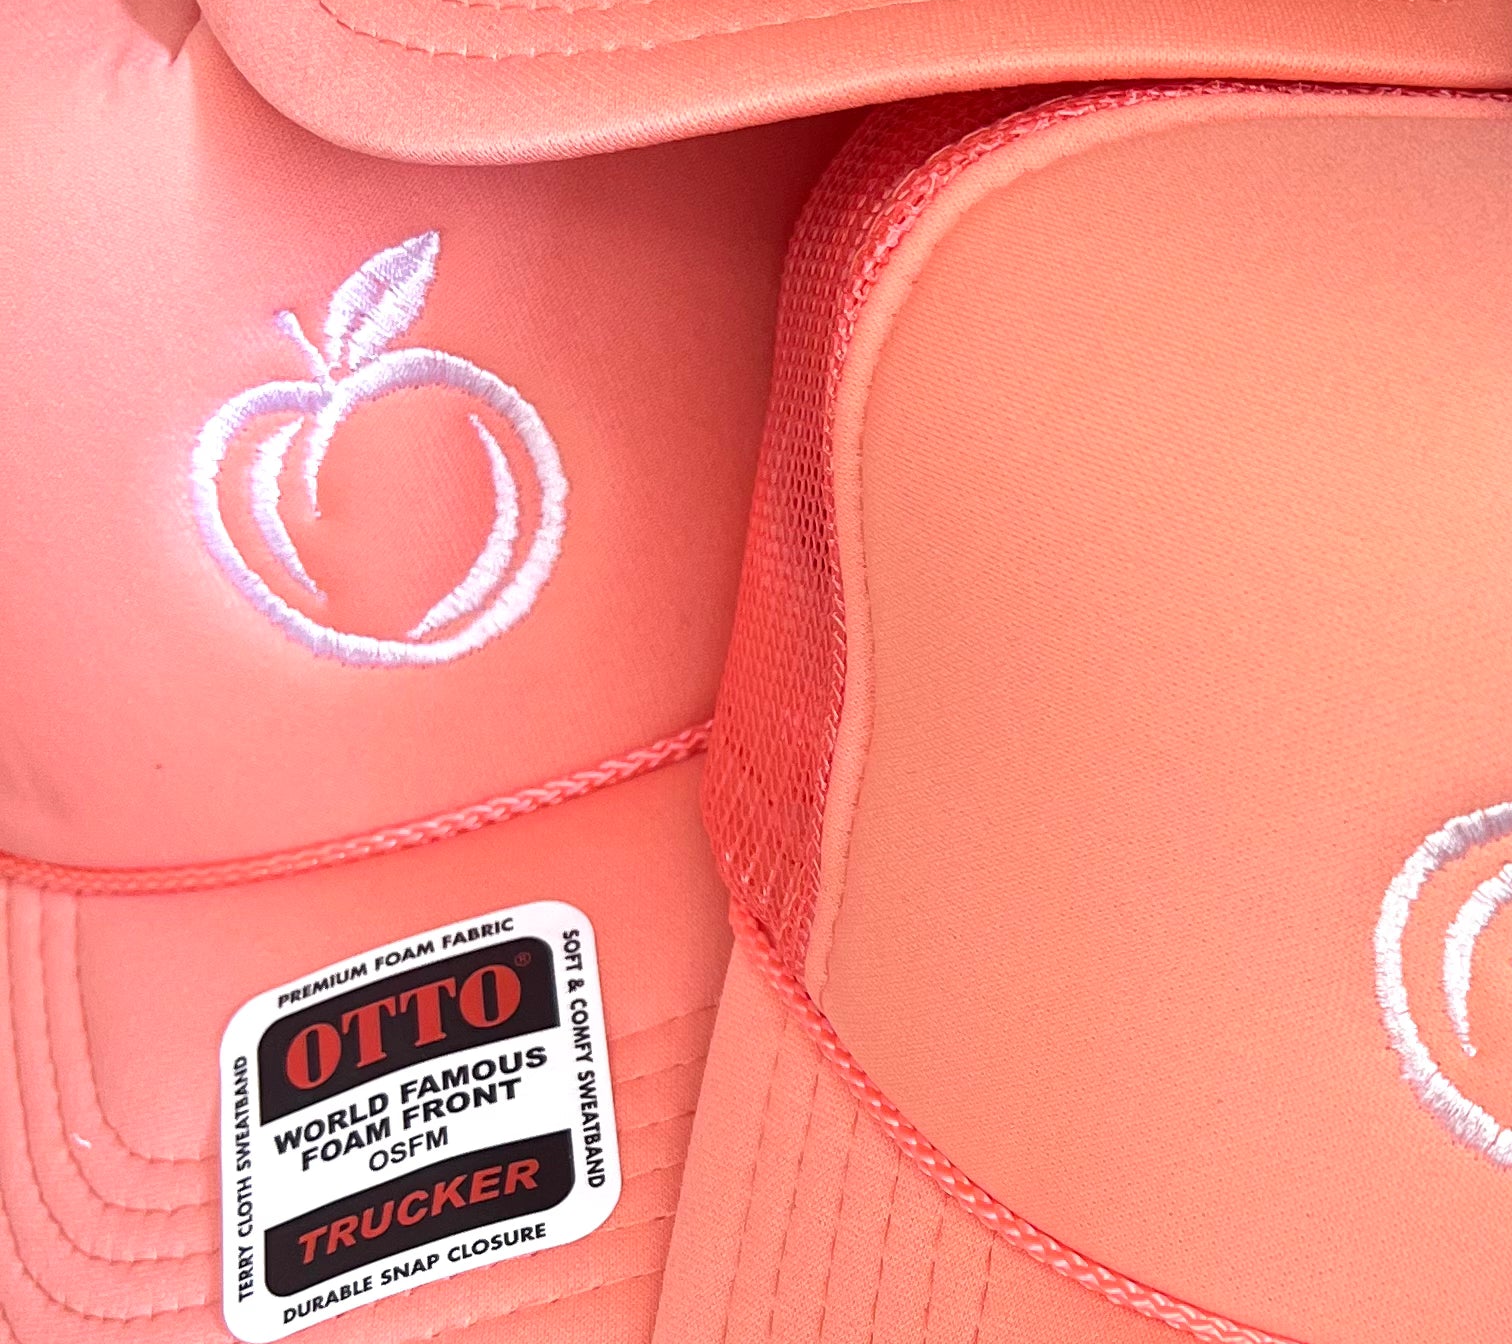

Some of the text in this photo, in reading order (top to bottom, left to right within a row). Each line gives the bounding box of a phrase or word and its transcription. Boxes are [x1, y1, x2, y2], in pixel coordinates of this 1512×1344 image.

[278, 918, 514, 1009] PREMIUM FOAM FABRIC
[273, 1046, 547, 1156] WORLD FAMOUS
[563, 929, 605, 1189] SOFT & COMFY SWEATBAND
[301, 1078, 522, 1171] FOAM FRONT
[368, 1126, 450, 1172] OSFM
[233, 1055, 254, 1302] TERRY CLOTH SWEATBAND
[298, 1158, 539, 1265] TRUCKER
[283, 1223, 547, 1324] DURABLE SNAP CLOSURE
